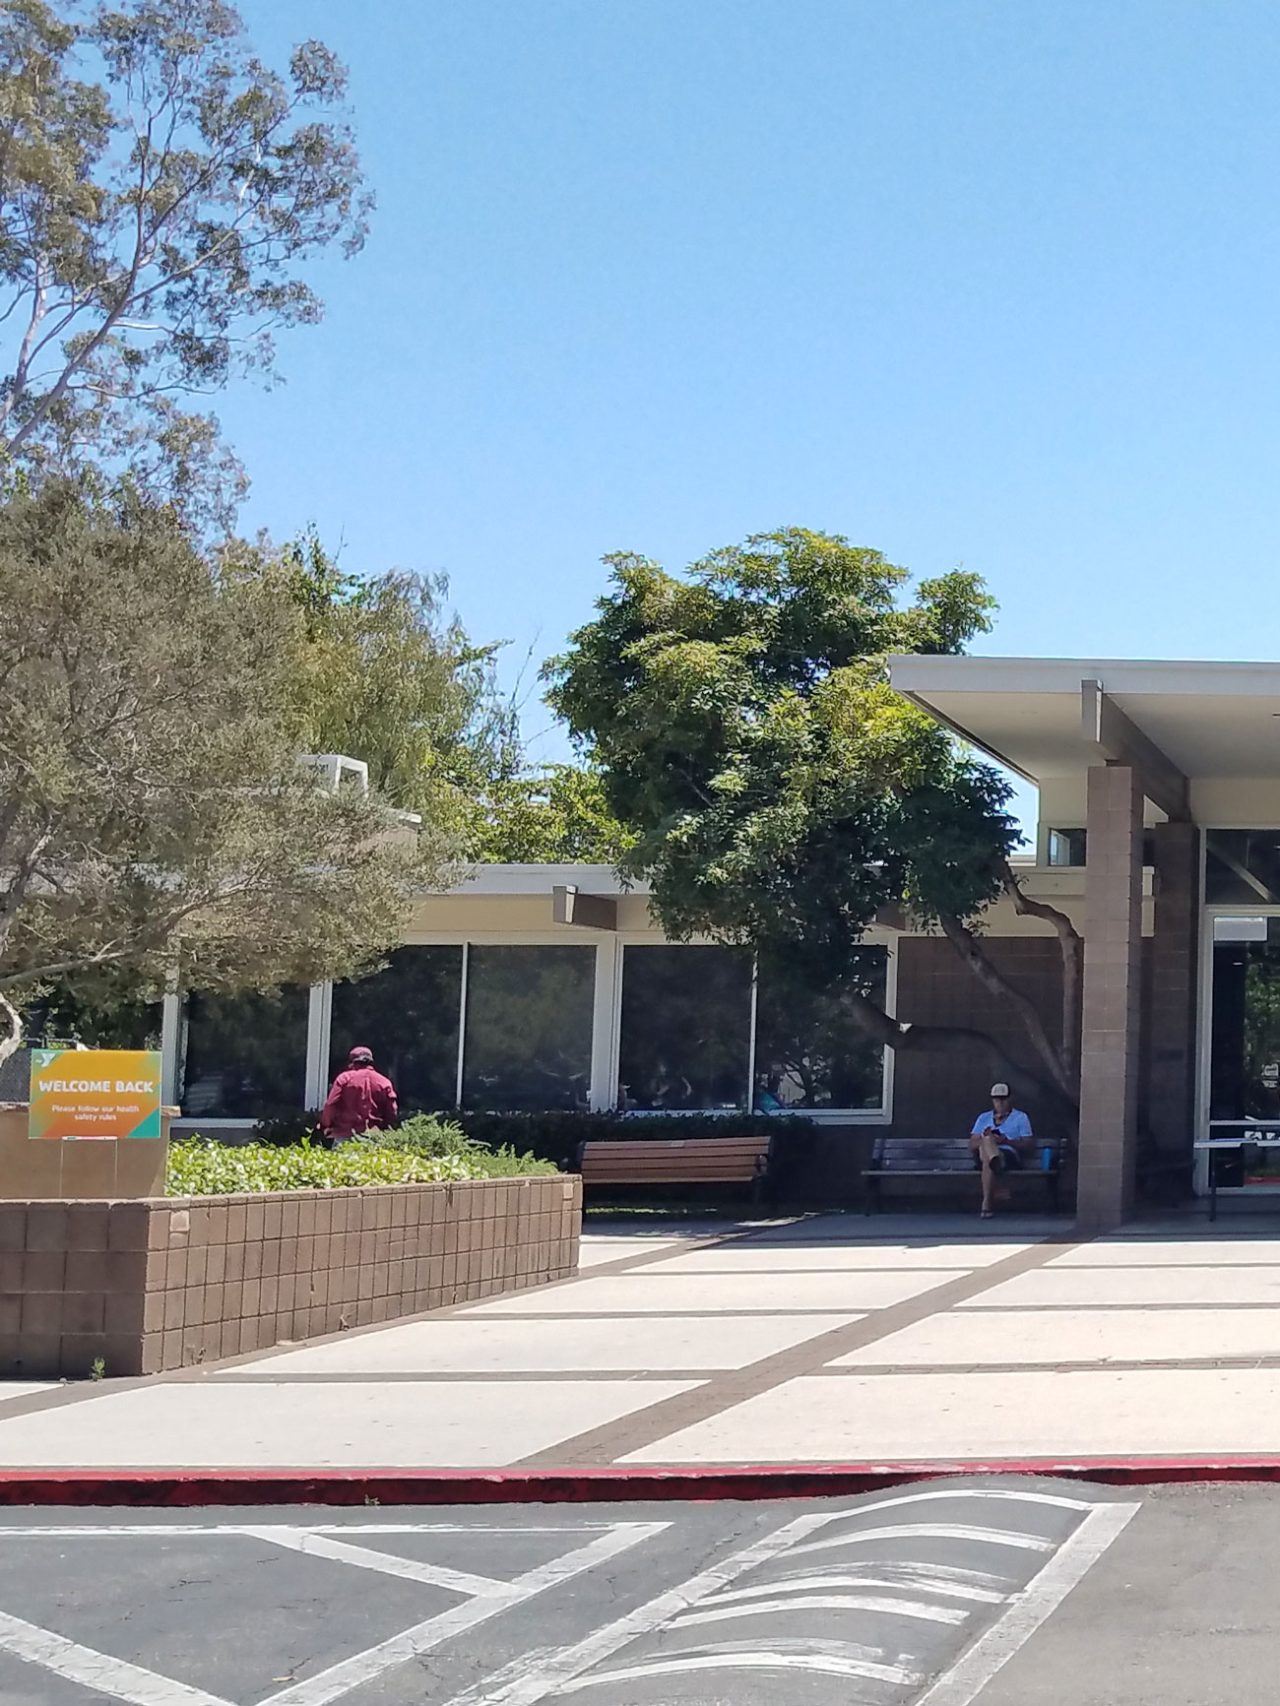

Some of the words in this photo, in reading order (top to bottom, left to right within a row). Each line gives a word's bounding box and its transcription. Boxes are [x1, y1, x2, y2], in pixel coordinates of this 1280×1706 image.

[39, 1081, 111, 1093] WELCOME
[115, 1081, 153, 1092] BACK
[52, 1104, 76, 1112] Please
[74, 1113, 97, 1122] safety
